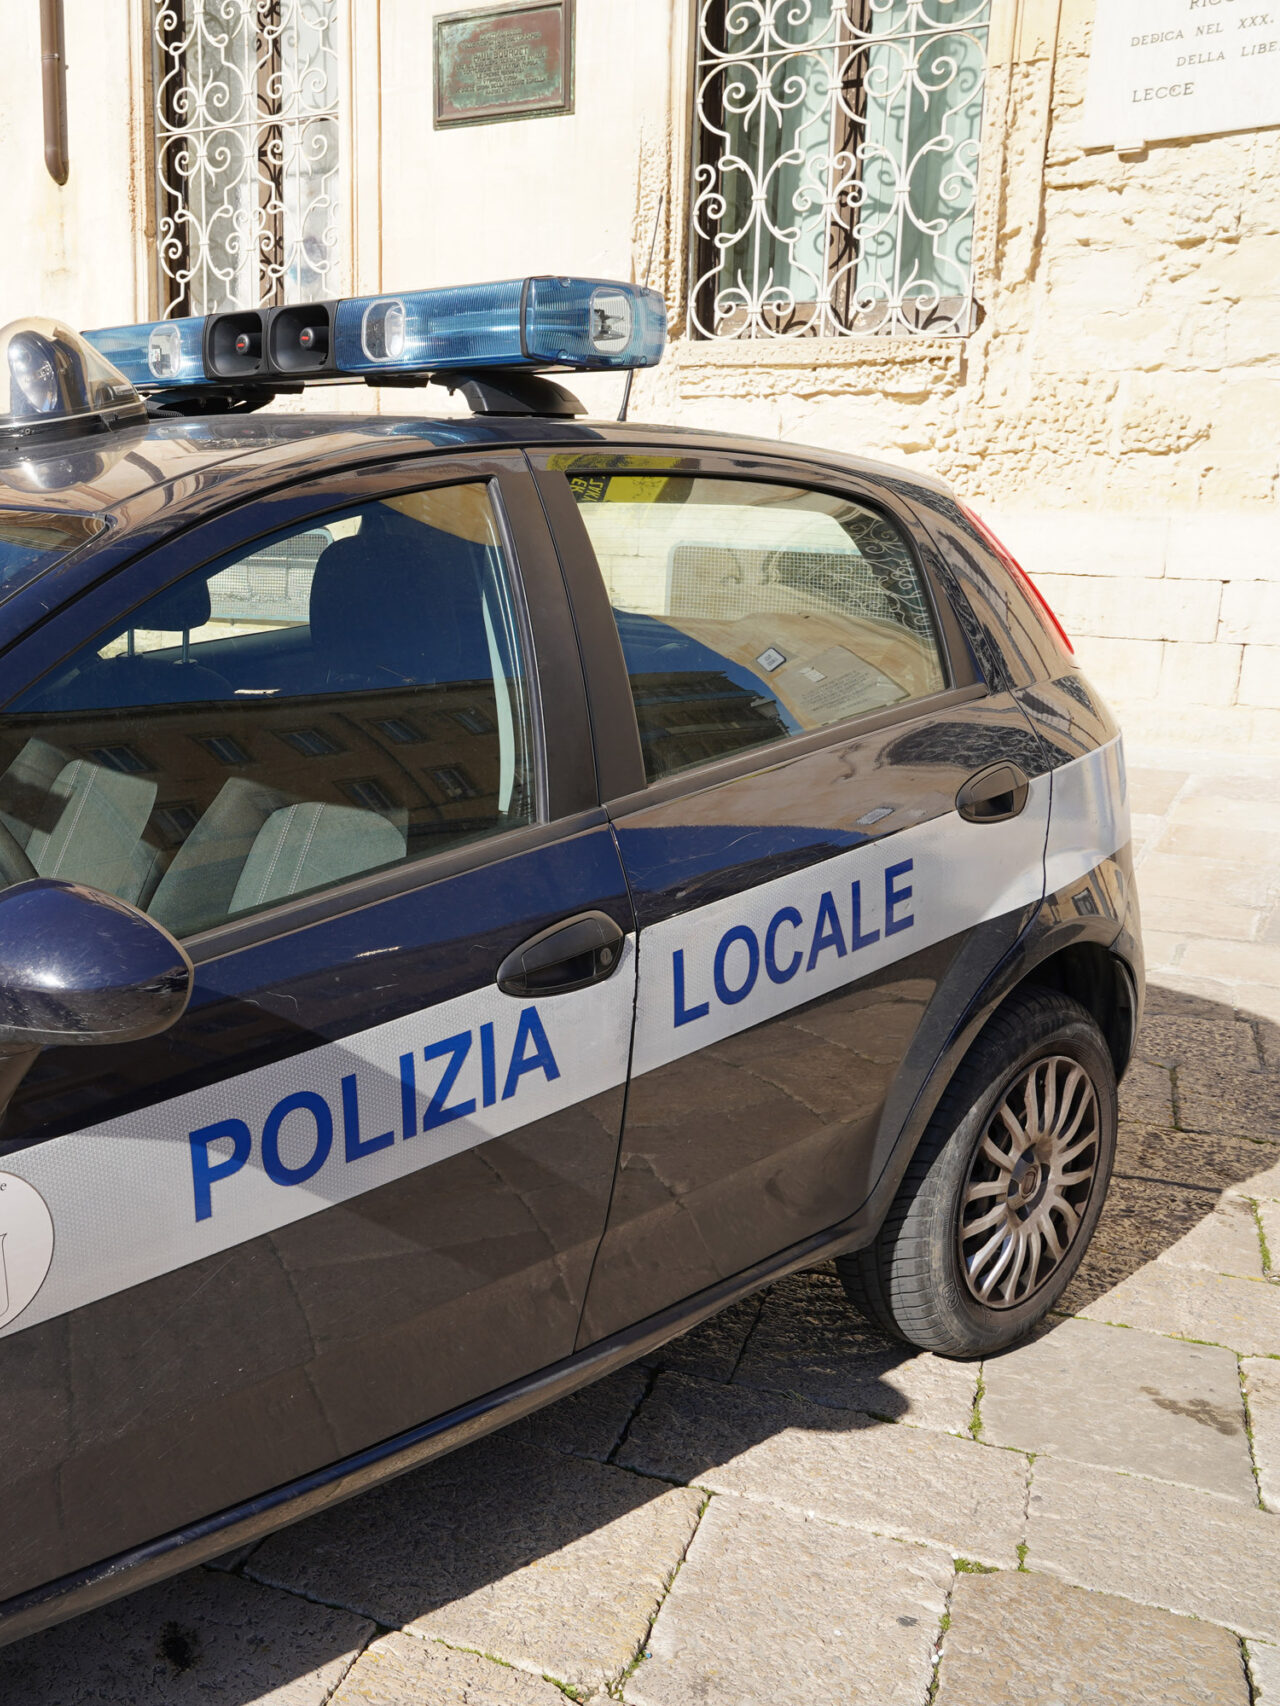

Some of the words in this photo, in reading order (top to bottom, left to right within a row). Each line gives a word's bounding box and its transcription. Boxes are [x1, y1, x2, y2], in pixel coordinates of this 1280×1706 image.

[1130, 29, 1184, 47] DEDICA
[1195, 22, 1224, 37] NEL
[1176, 51, 1226, 67] DELLA
[1240, 40, 1280, 57] LIBE
[1131, 82, 1195, 103] LECCE
[188, 1005, 562, 1223] POLIZIA
[672, 857, 915, 1029] LOCALE
